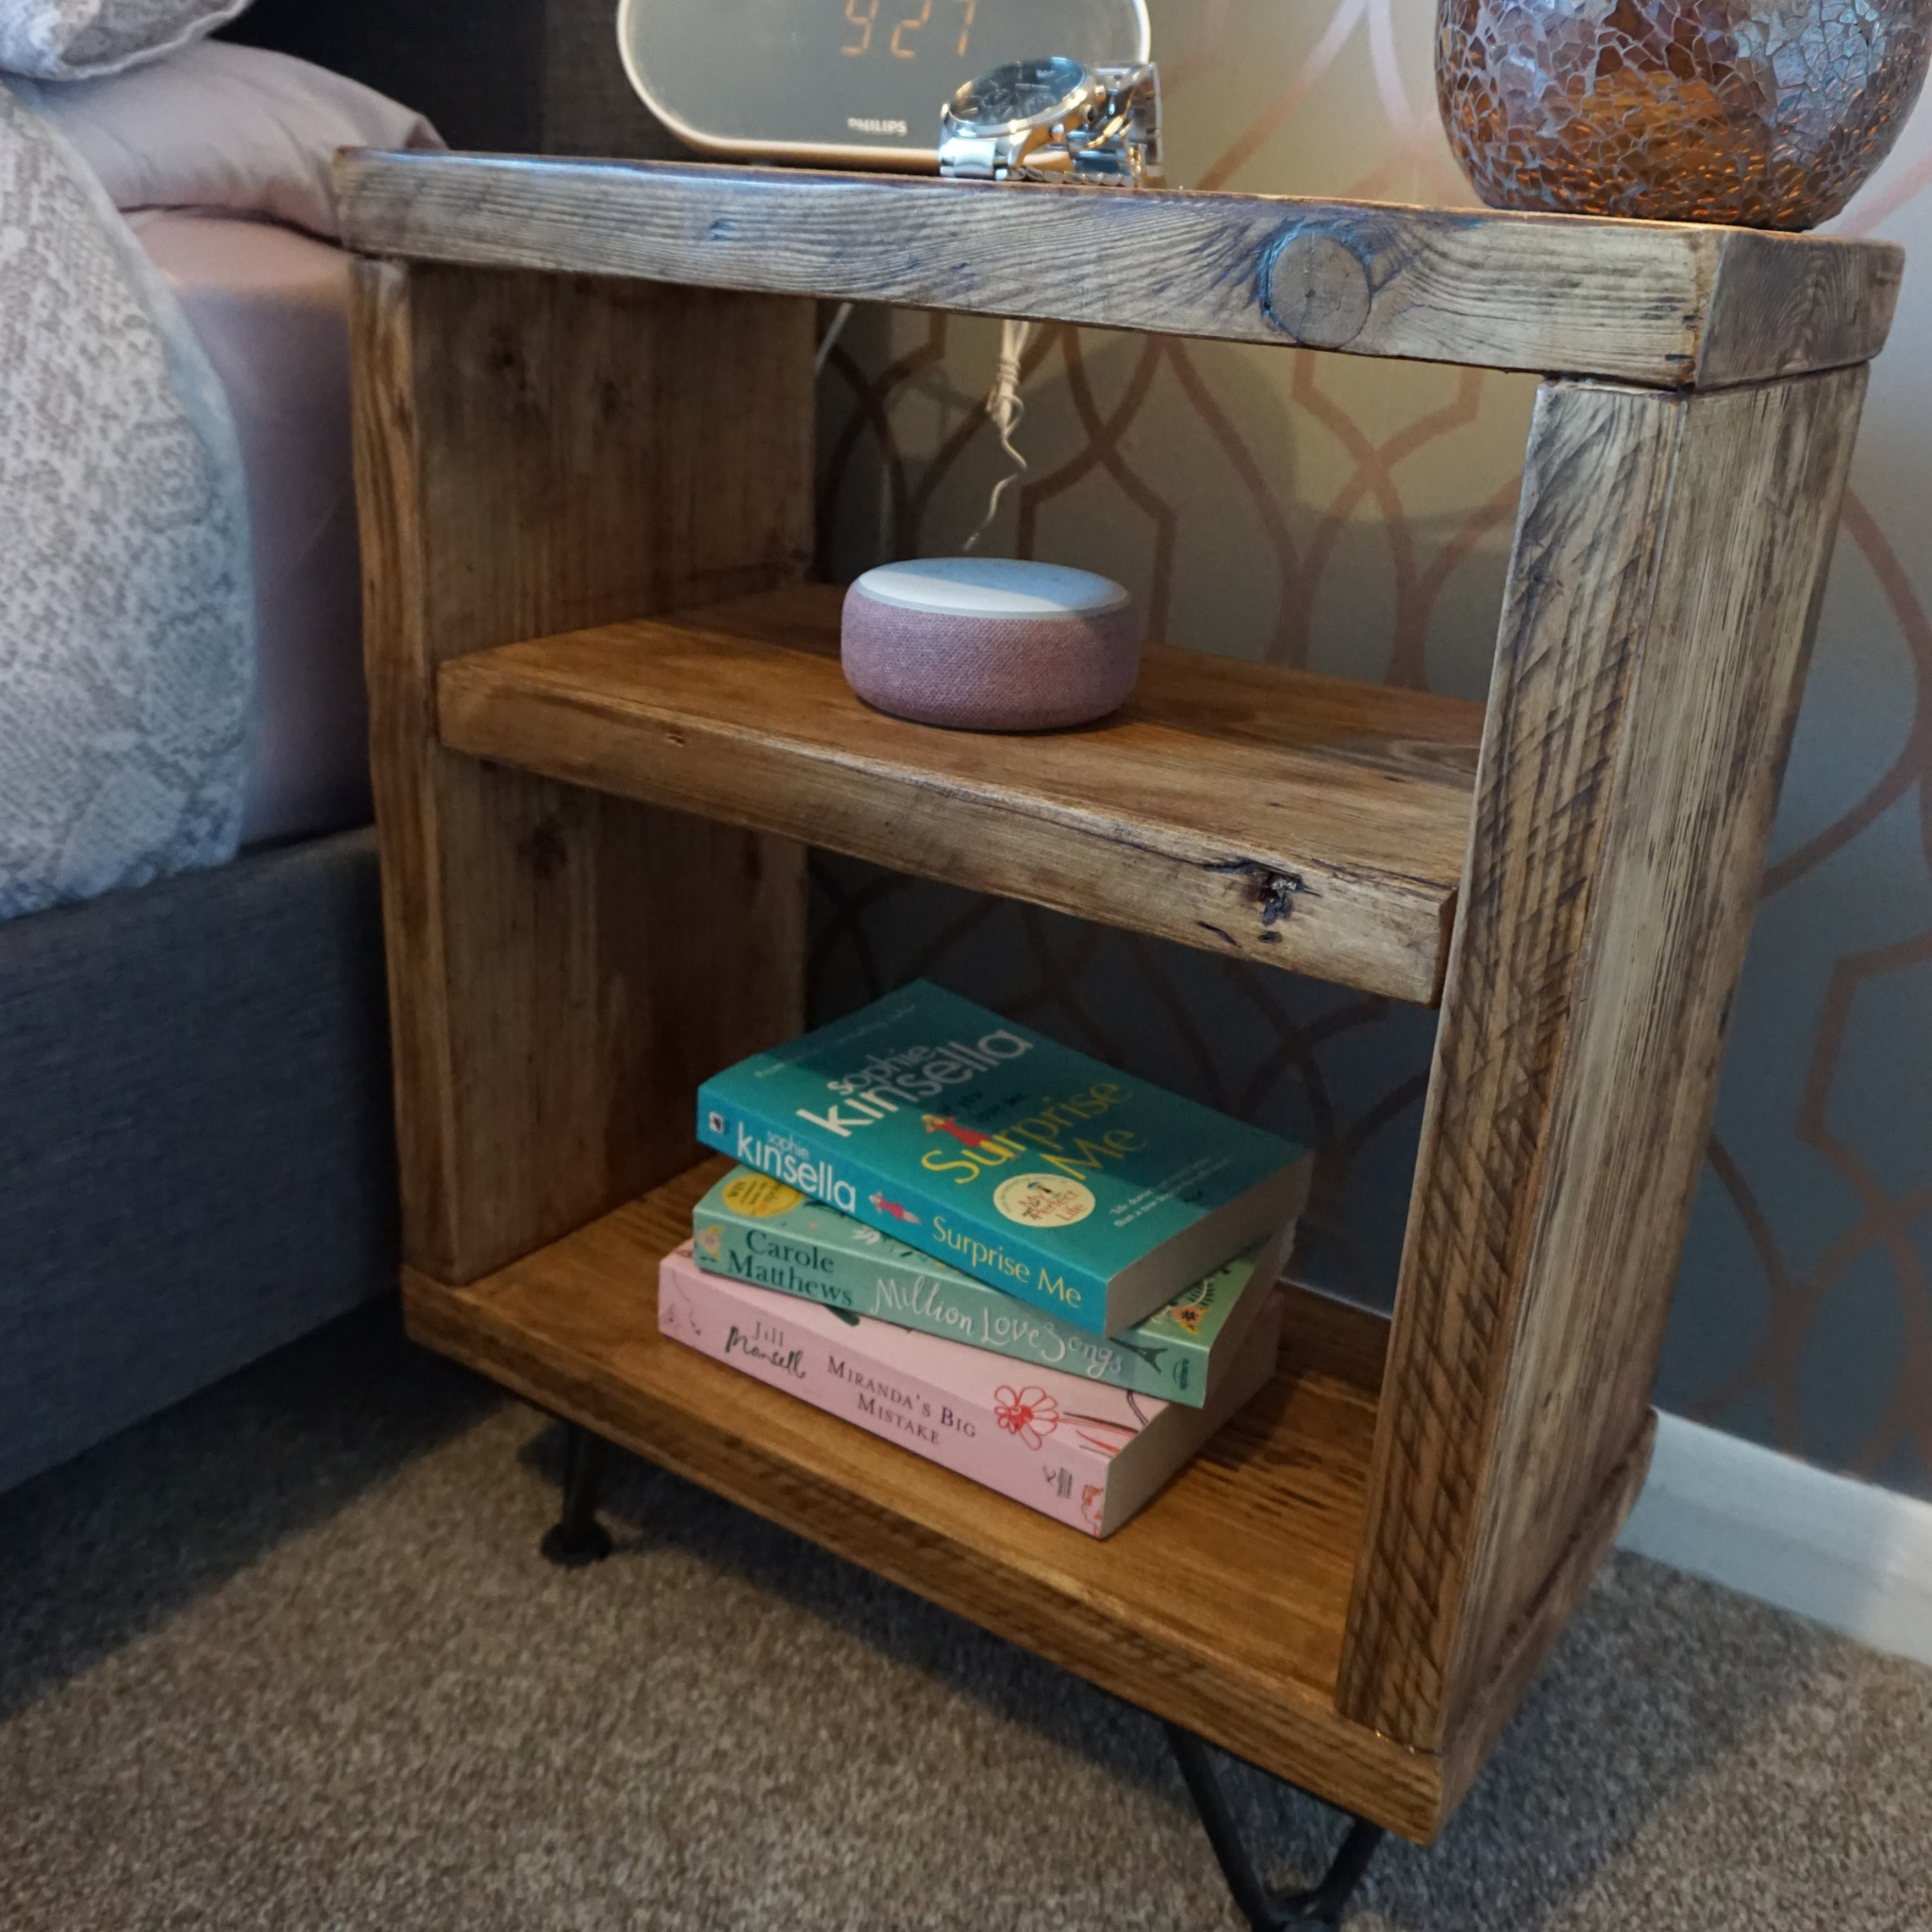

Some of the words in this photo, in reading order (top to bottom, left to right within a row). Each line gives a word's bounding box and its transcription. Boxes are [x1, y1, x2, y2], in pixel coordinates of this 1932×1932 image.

[847, 117, 908, 136] PHILIPS
[795, 1029, 1034, 1138] kinsella
[827, 1045, 935, 1095] sophie
[767, 1130, 809, 1160] sophie
[922, 1084, 1131, 1185] Surprise
[1040, 1130, 1147, 1180] Me
[738, 1122, 857, 1213] kinsella
[933, 1216, 1030, 1284] Surprise
[1039, 1267, 1082, 1308] Me
[745, 1229, 834, 1274] Carole
[727, 1249, 853, 1307] Matthews
[724, 1325, 807, 1379] Mansell
[753, 1321, 783, 1347] Jill
[870, 1274, 974, 1337] Million
[980, 1307, 1041, 1346] Love
[1041, 1323, 1124, 1378] Songs
